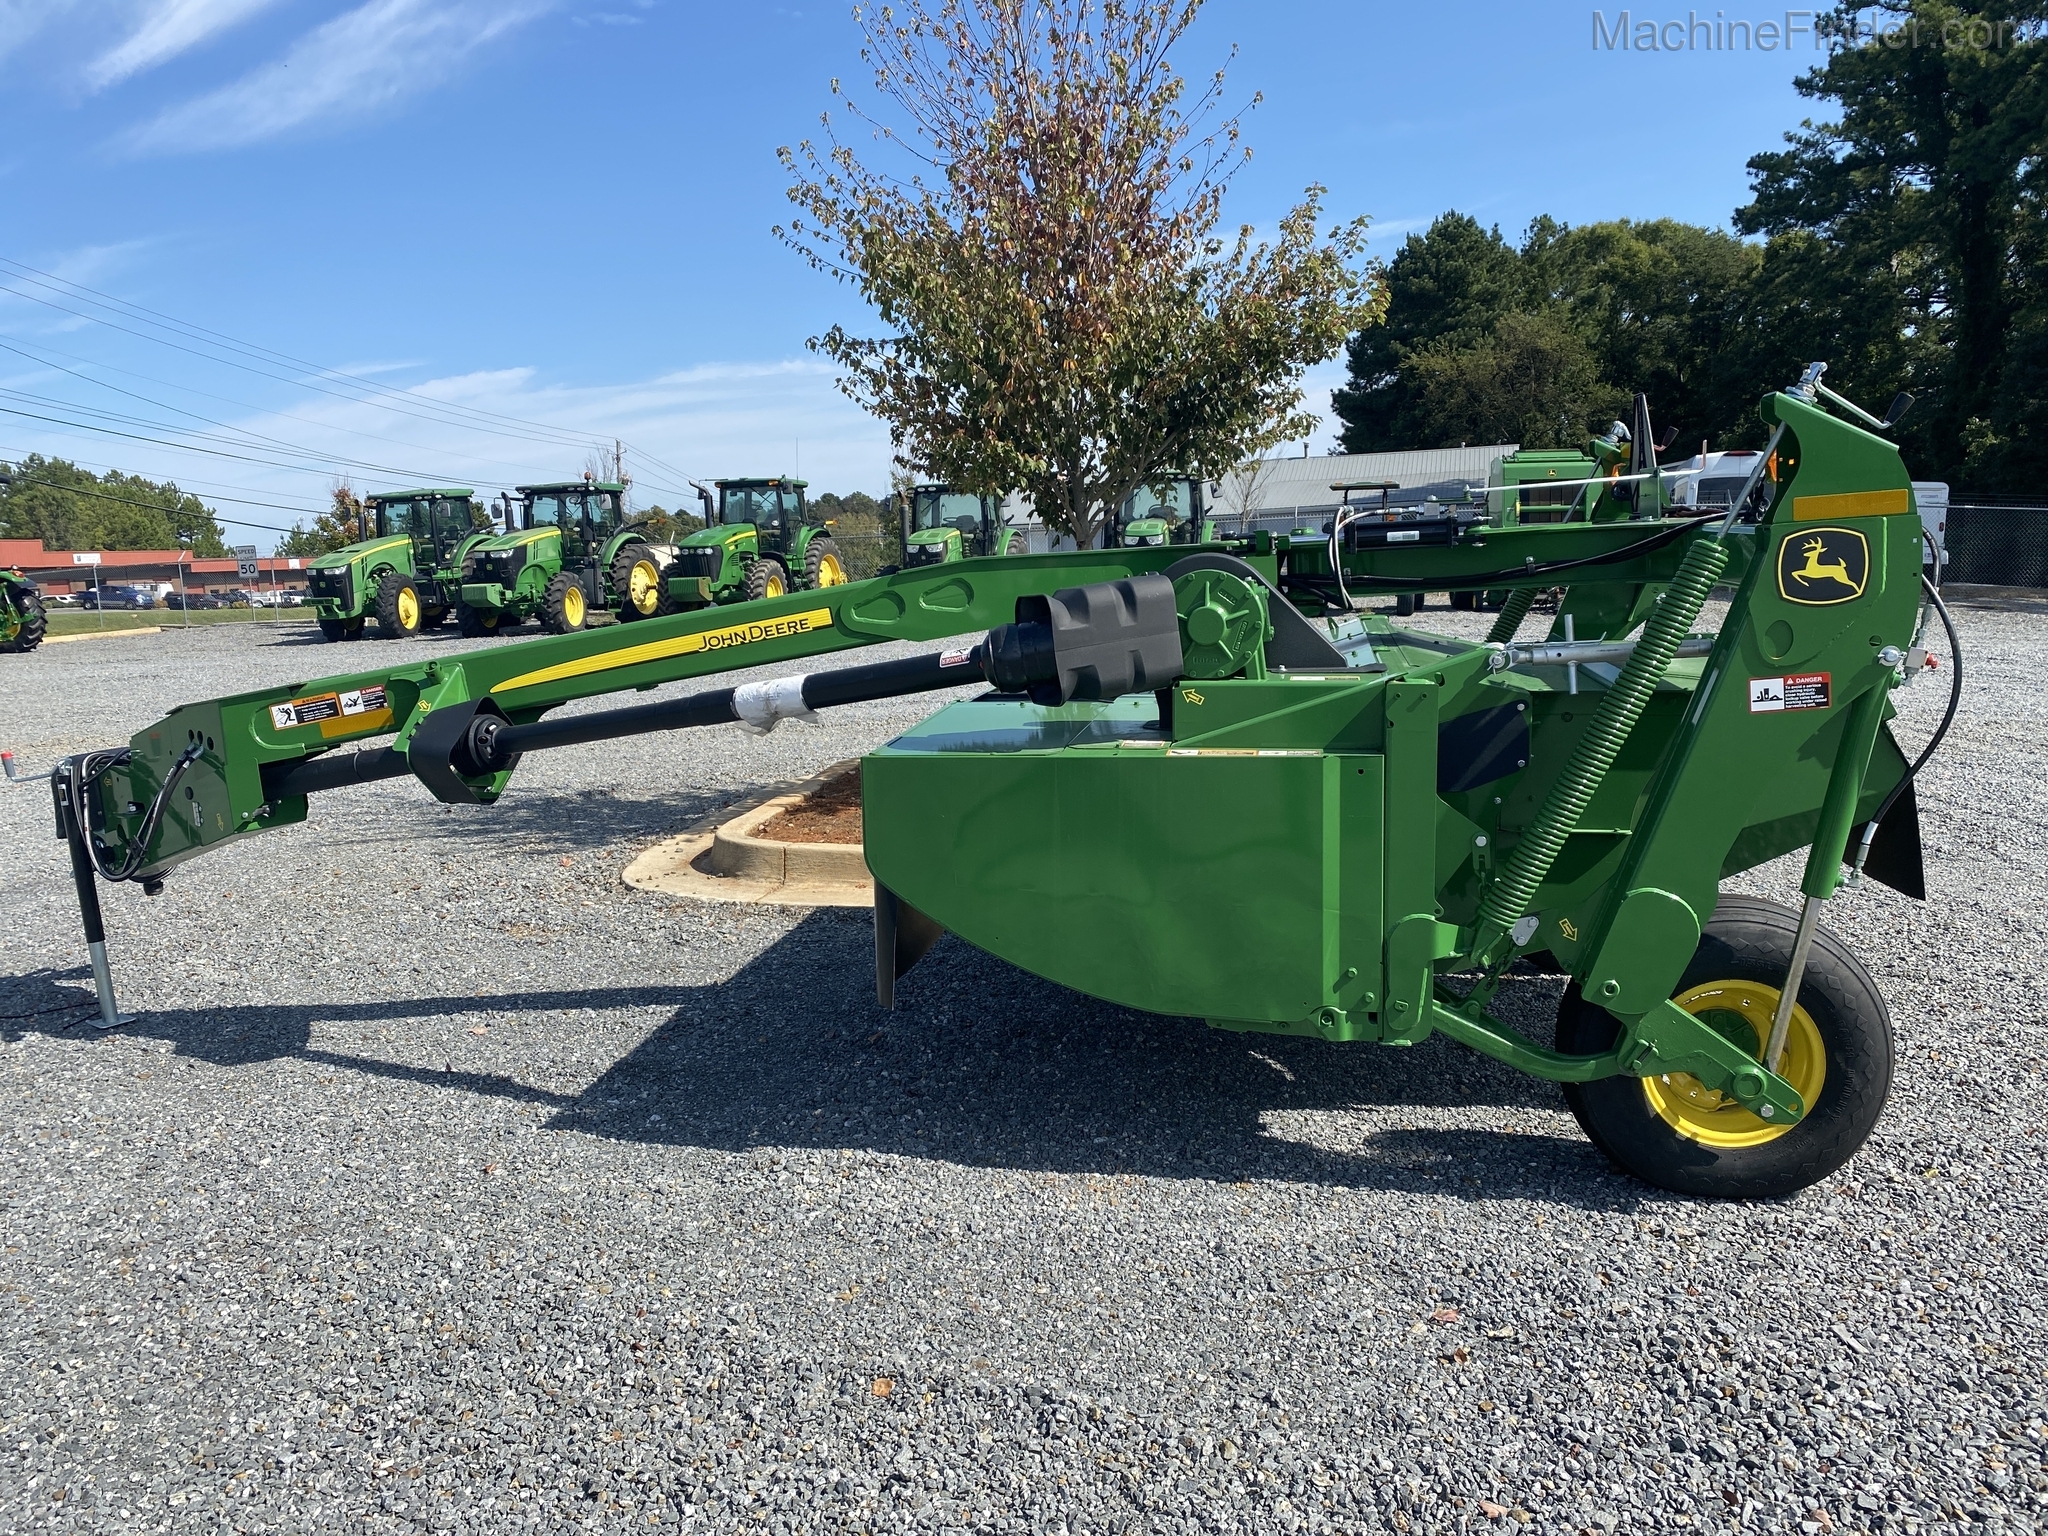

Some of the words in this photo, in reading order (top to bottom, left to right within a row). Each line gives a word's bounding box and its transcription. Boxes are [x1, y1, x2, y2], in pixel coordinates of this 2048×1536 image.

[240, 564, 256, 574] 50
[698, 630, 747, 650] JOHN
[749, 618, 811, 640] DEERE
